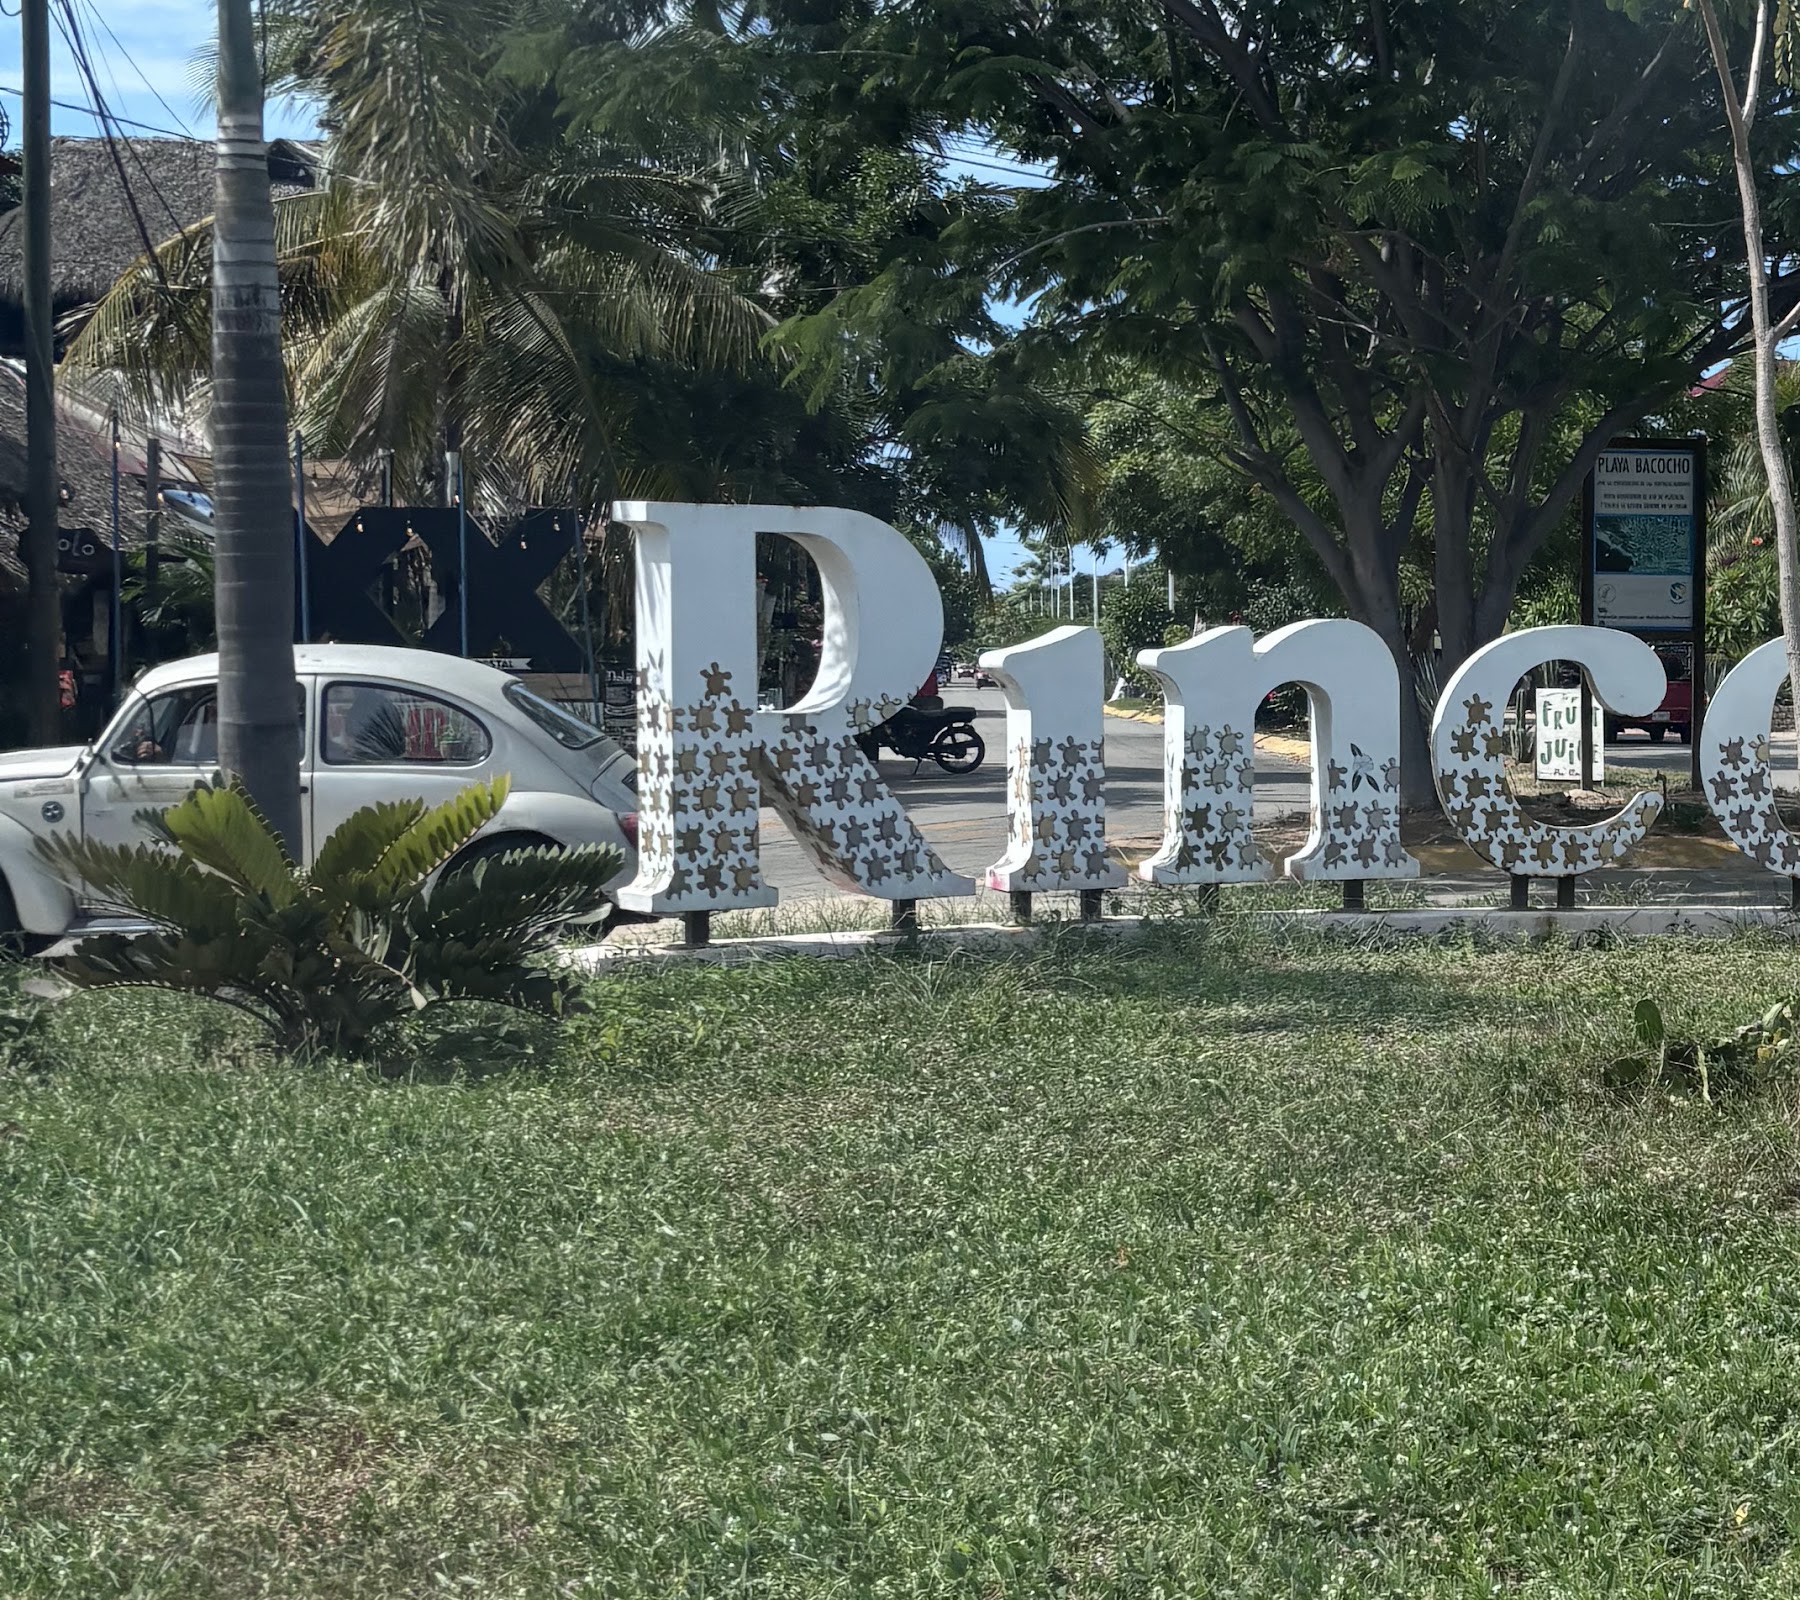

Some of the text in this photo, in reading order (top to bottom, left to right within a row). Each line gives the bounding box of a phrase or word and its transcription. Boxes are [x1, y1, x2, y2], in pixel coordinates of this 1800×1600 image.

[1598, 457, 1690, 474] PLAYA BACOCHO
[1542, 700, 1600, 730] FRUT
